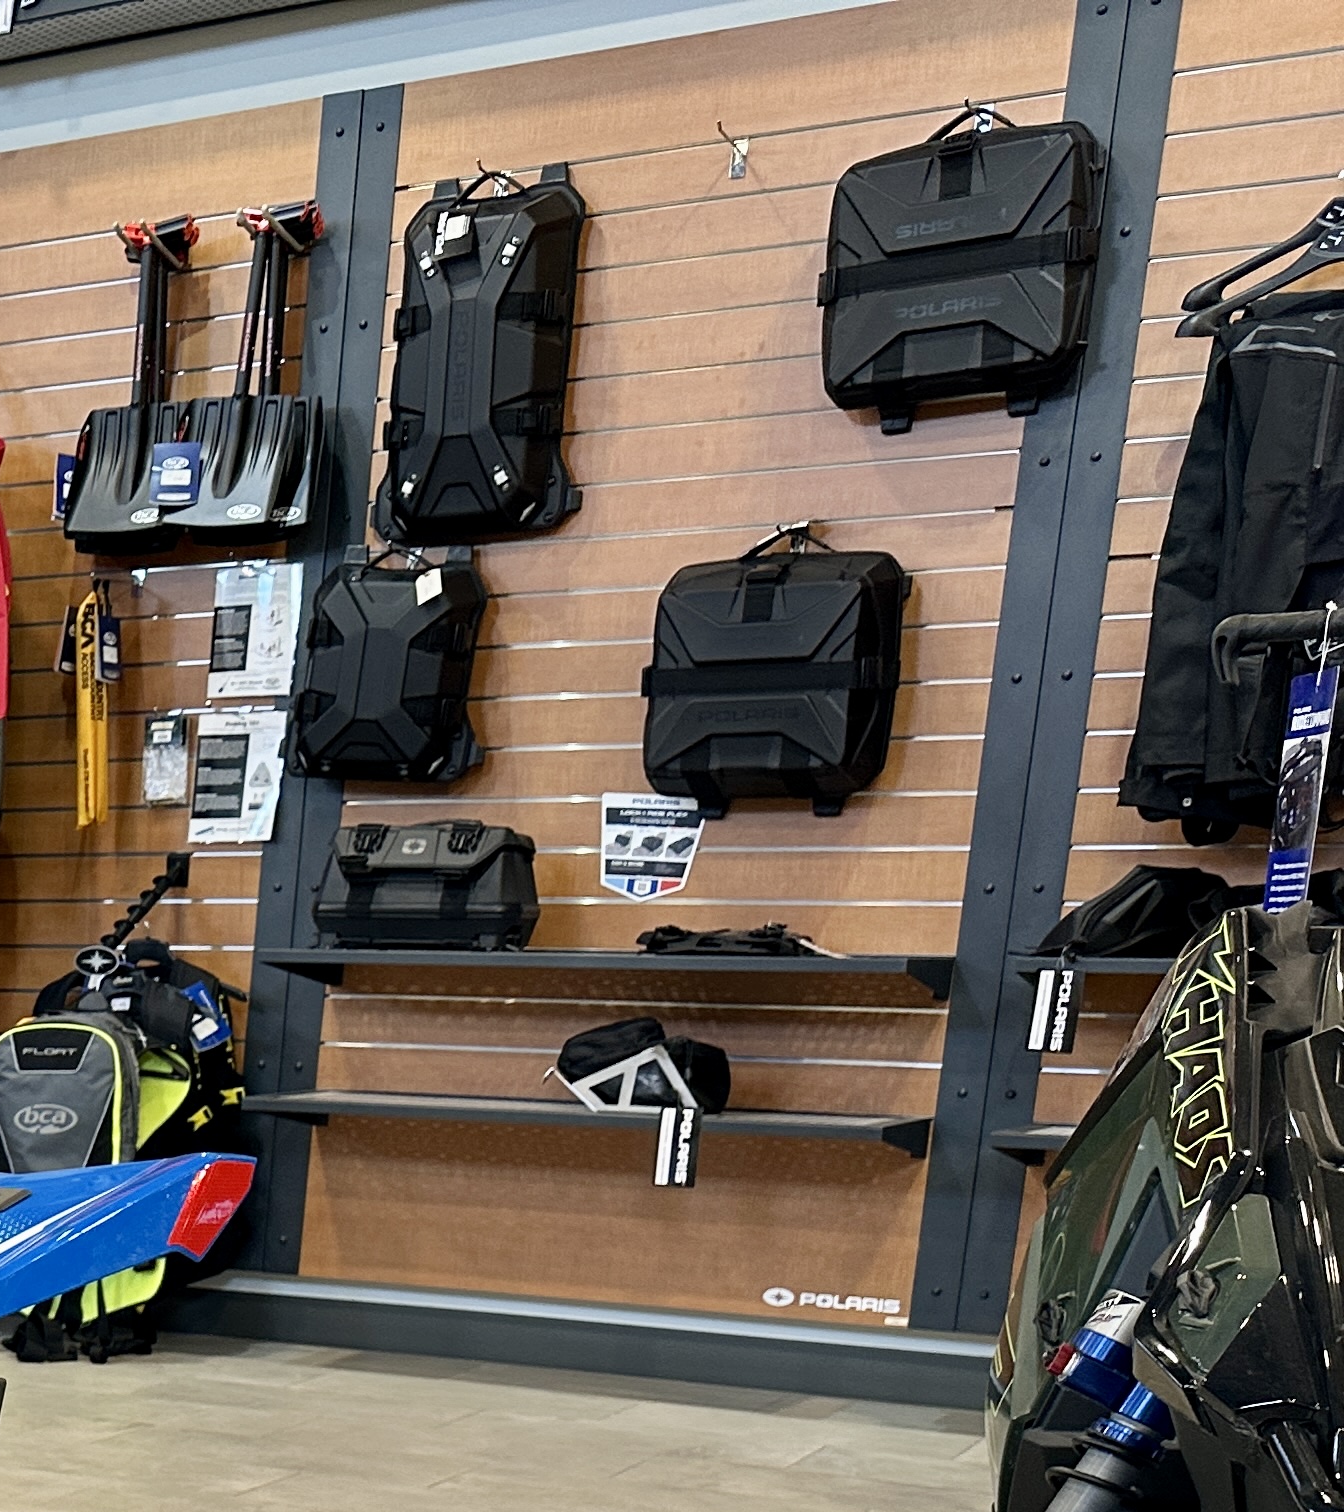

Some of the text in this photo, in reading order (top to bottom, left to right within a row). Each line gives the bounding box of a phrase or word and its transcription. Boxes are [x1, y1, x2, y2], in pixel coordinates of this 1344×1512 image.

[81, 603, 96, 650] BCA
[81, 652, 89, 690] ACCESS
[1050, 970, 1074, 1053] POLARIS
[21, 1047, 78, 1056] FLOAT
[1161, 914, 1236, 1209] KHAOS
[23, 1107, 67, 1125] bca
[674, 1108, 694, 1186] POLARIS
[799, 1292, 901, 1314] POLARIS
